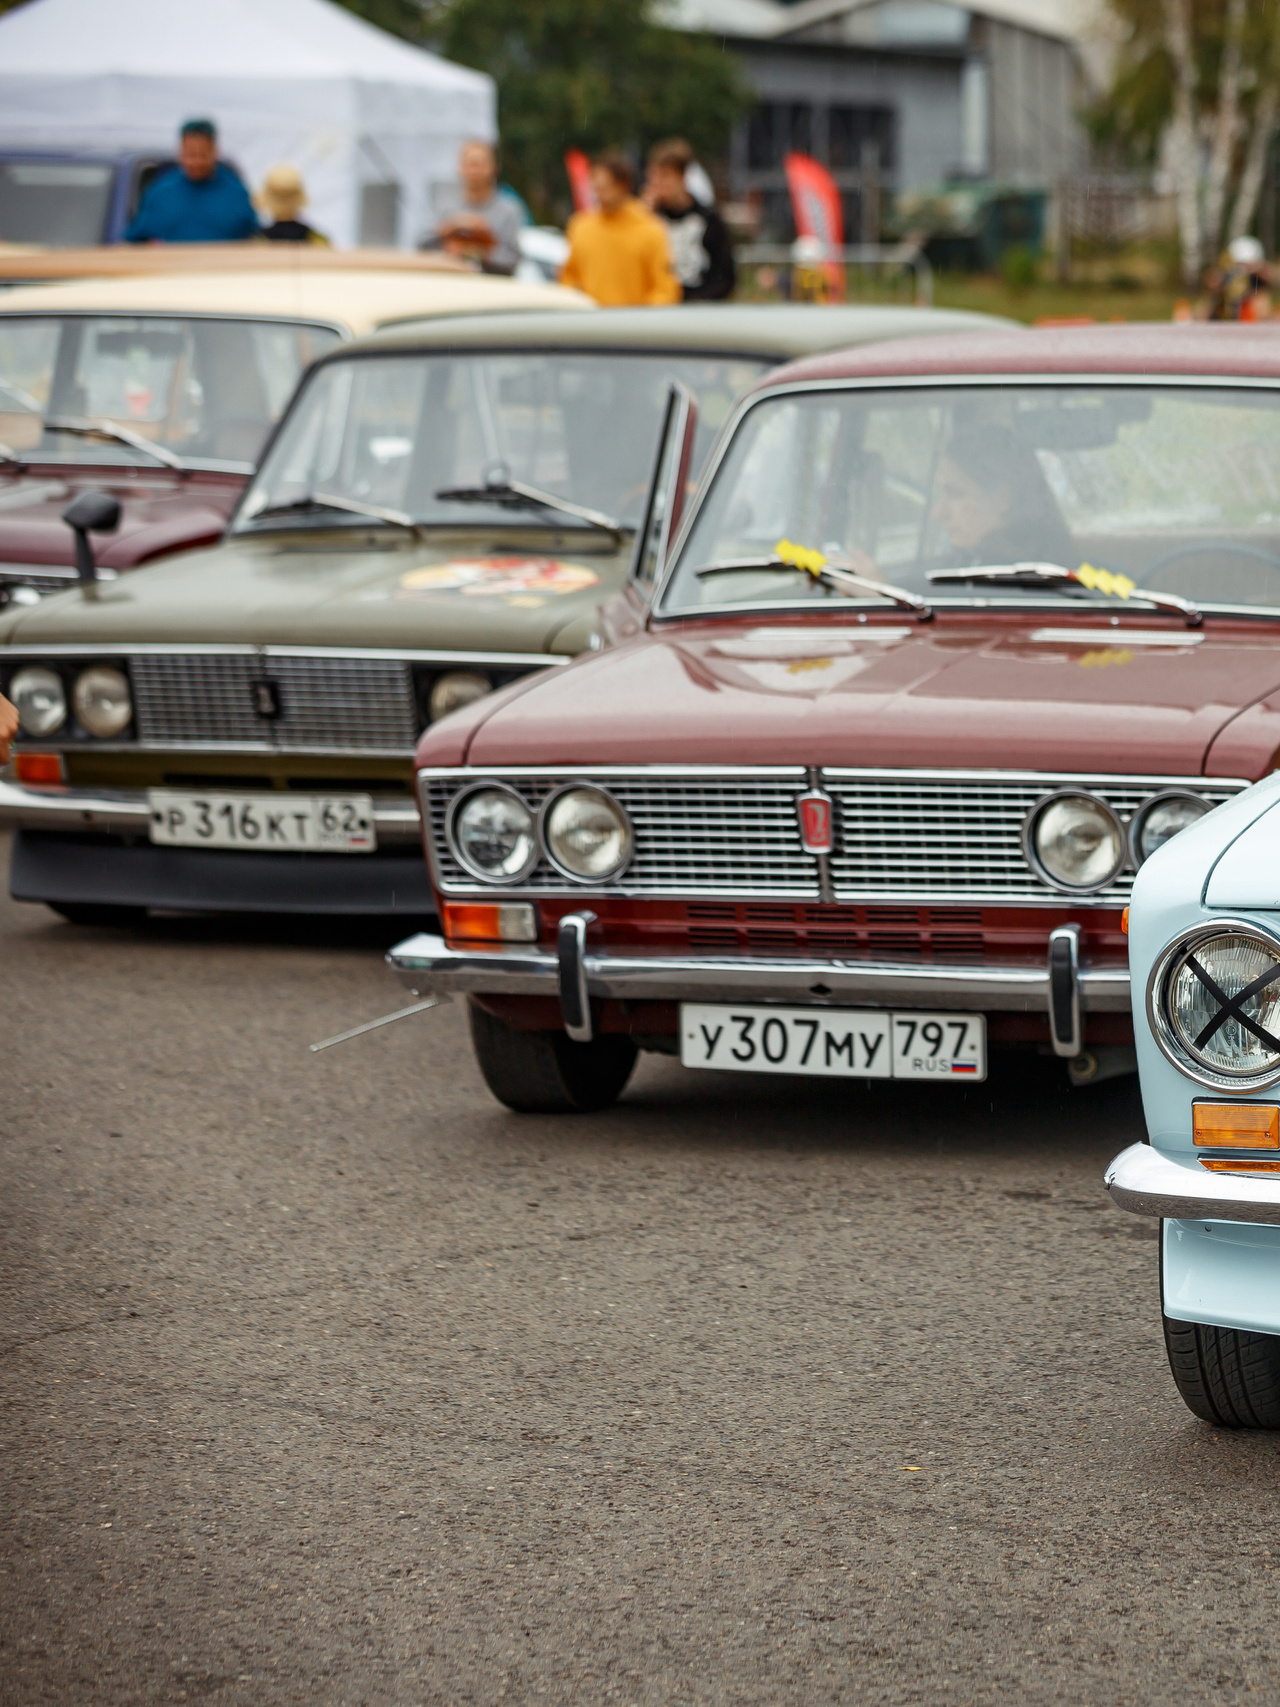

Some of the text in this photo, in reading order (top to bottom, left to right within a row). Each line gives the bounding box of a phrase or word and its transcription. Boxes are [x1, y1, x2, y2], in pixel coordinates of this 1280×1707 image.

[321, 803, 358, 832] 62
[700, 1014, 969, 1069] У307МУ 797
[912, 1057, 949, 1073] RUS
